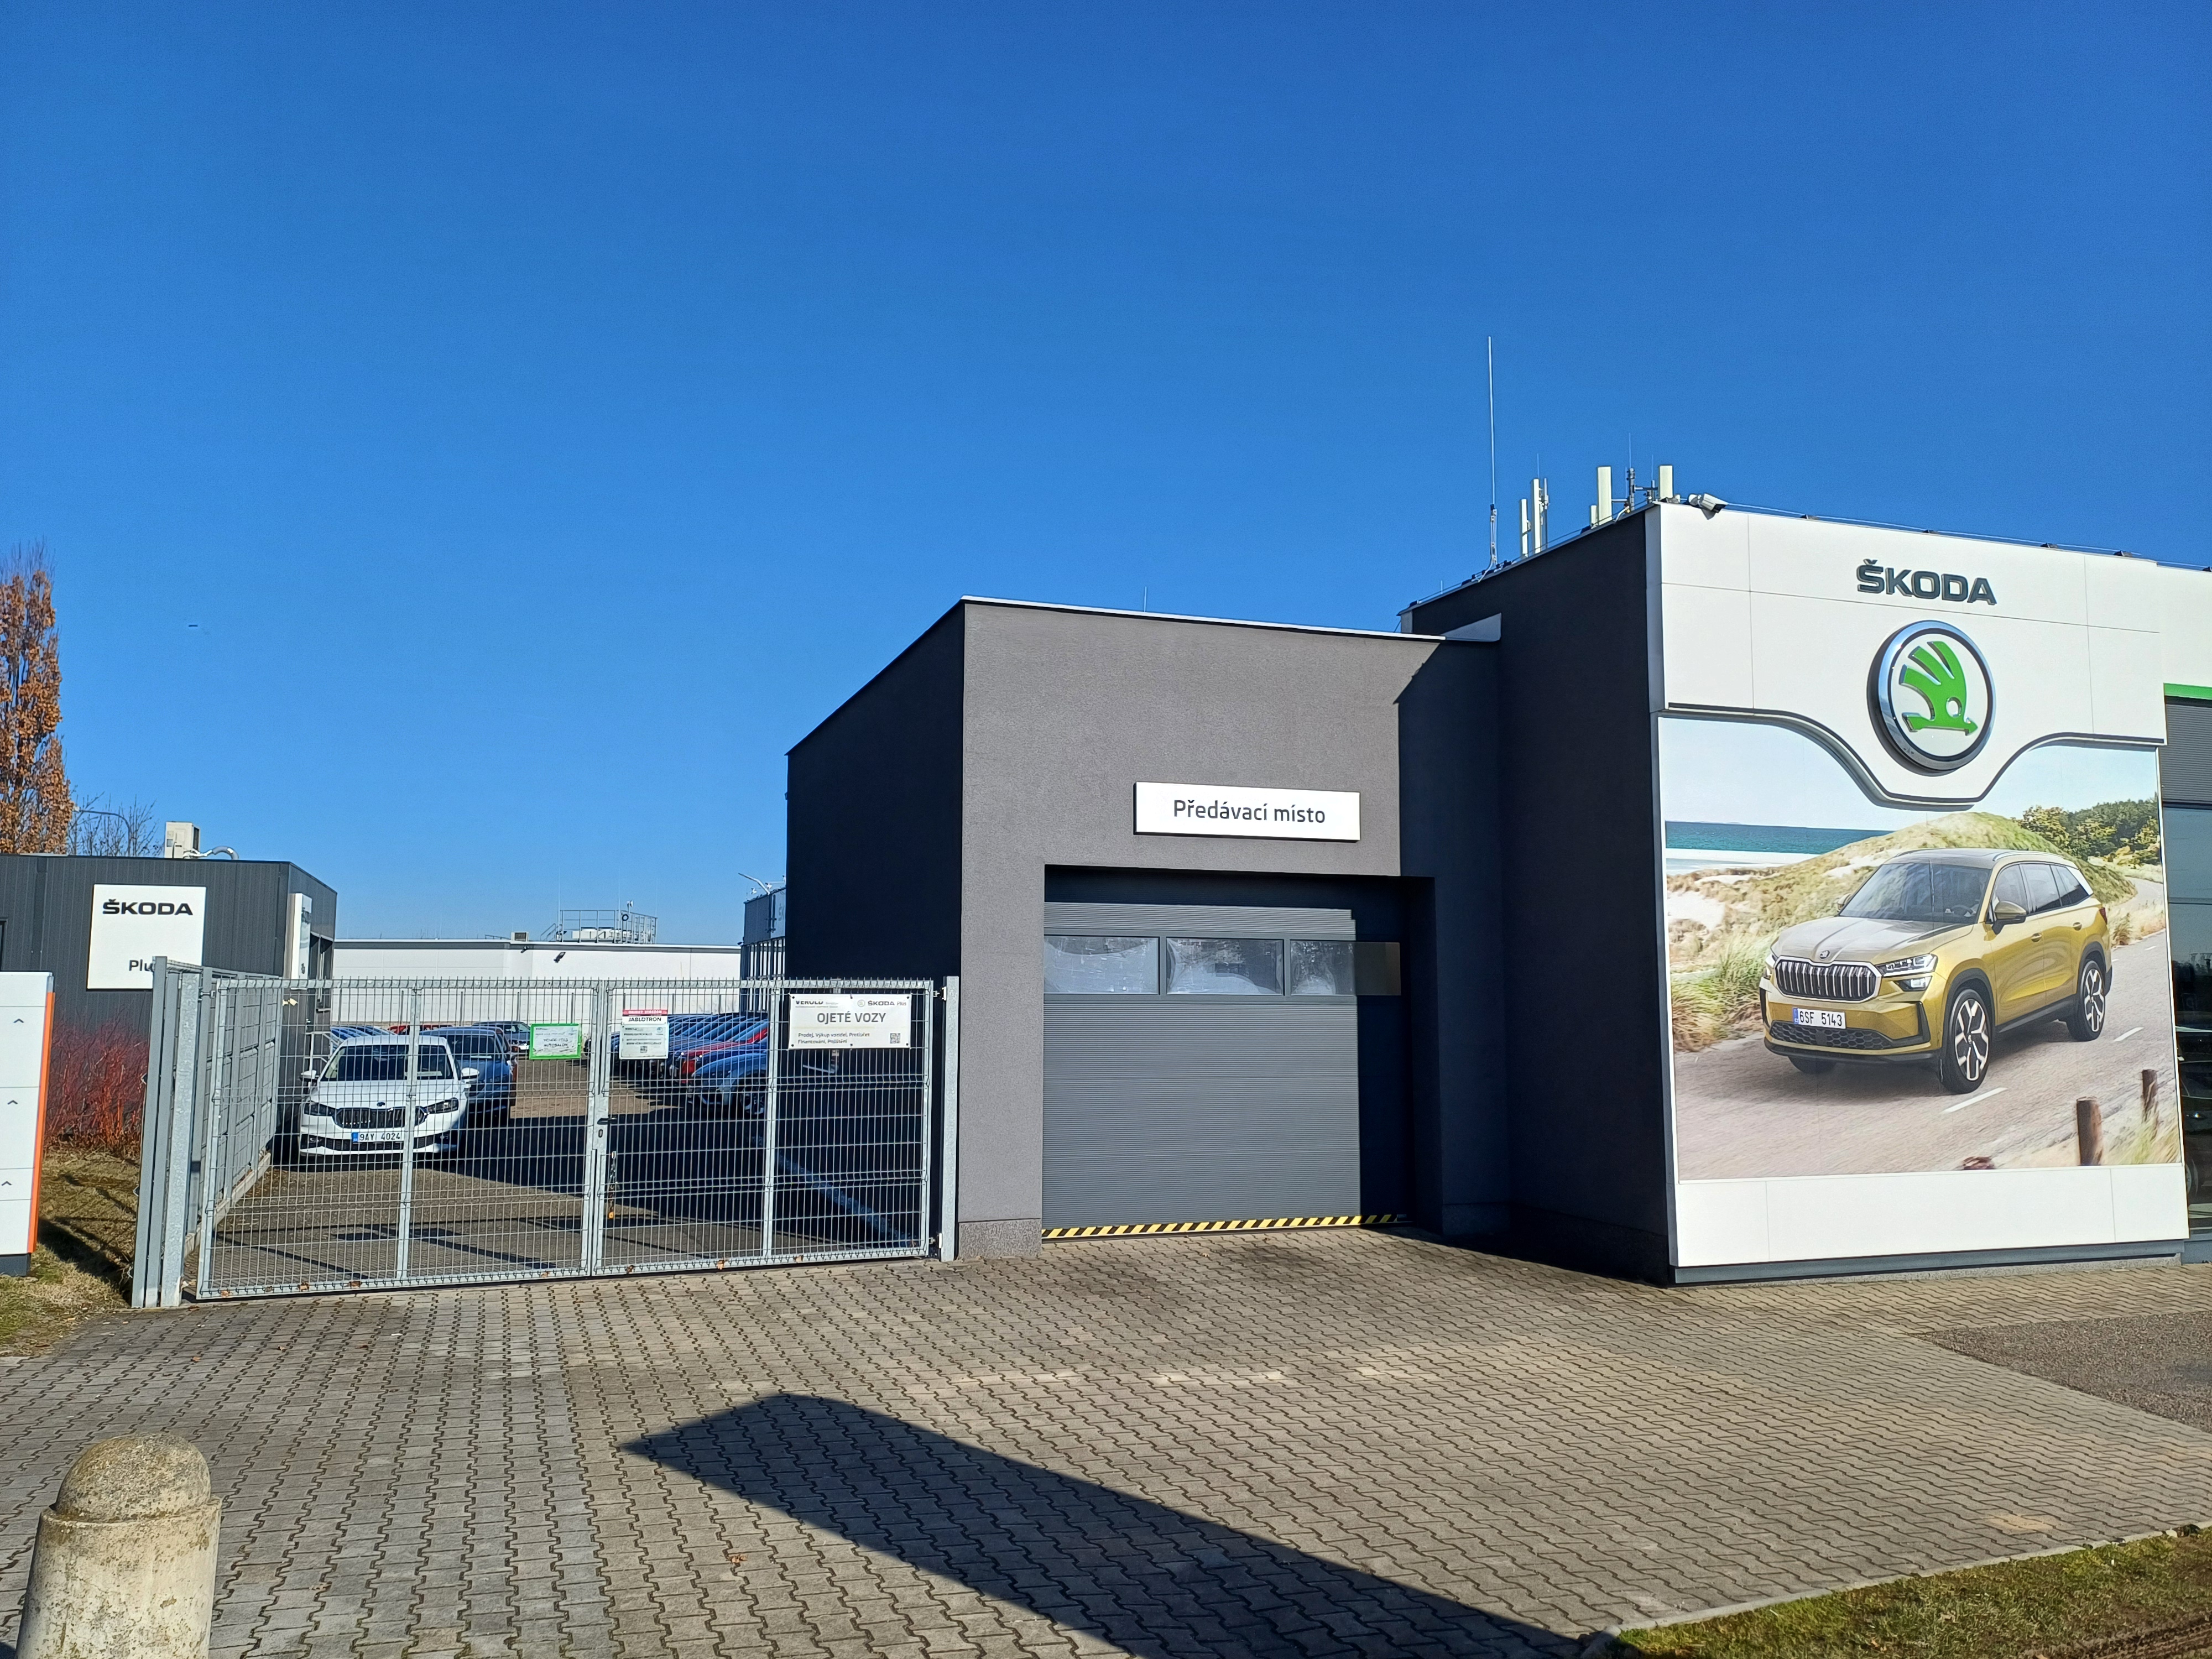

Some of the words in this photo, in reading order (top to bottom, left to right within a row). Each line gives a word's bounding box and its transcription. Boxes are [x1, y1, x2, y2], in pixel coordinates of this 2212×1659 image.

[1856, 558, 1997, 606] ŠKODA
[1173, 800, 1268, 821] Předávací
[1274, 804, 1326, 823] místo
[102, 899, 194, 916] ŠKODA
[129, 959, 154, 972] Plu
[817, 1011, 852, 1025] OJETÉ
[854, 1013, 886, 1022] VOZY
[1799, 1010, 1814, 1024] 6SF
[1821, 1013, 1842, 1026] 5143
[381, 1133, 400, 1141] 4024
